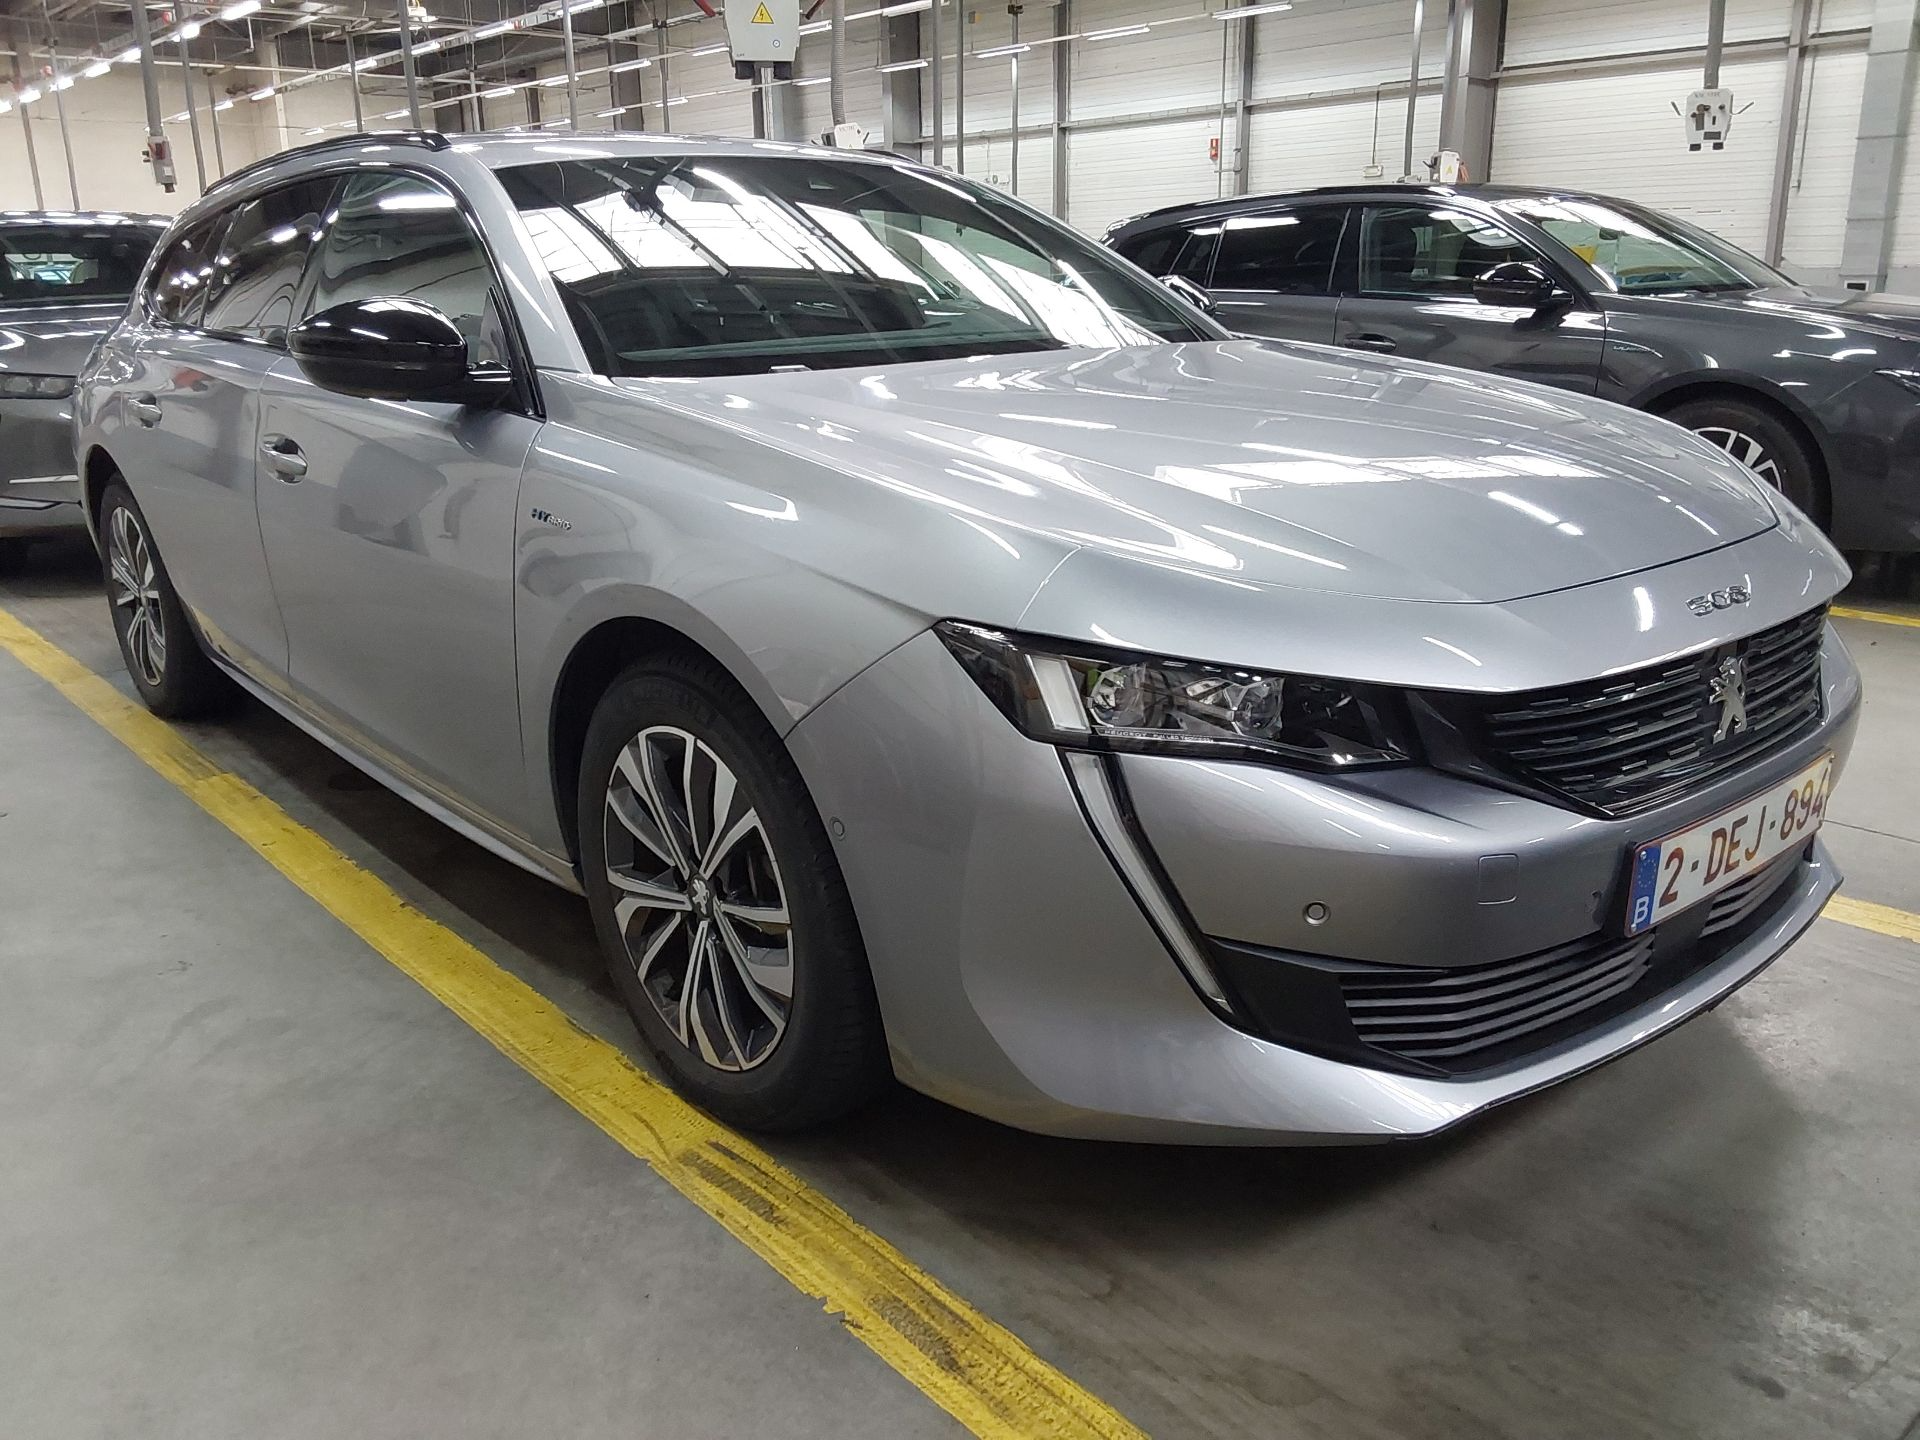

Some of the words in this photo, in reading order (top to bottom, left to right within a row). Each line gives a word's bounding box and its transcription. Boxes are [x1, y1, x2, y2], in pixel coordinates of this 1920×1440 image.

[1685, 585, 1751, 617] 508
[1658, 767, 1829, 909] 2-DEJ-894
[1633, 895, 1649, 923] B
